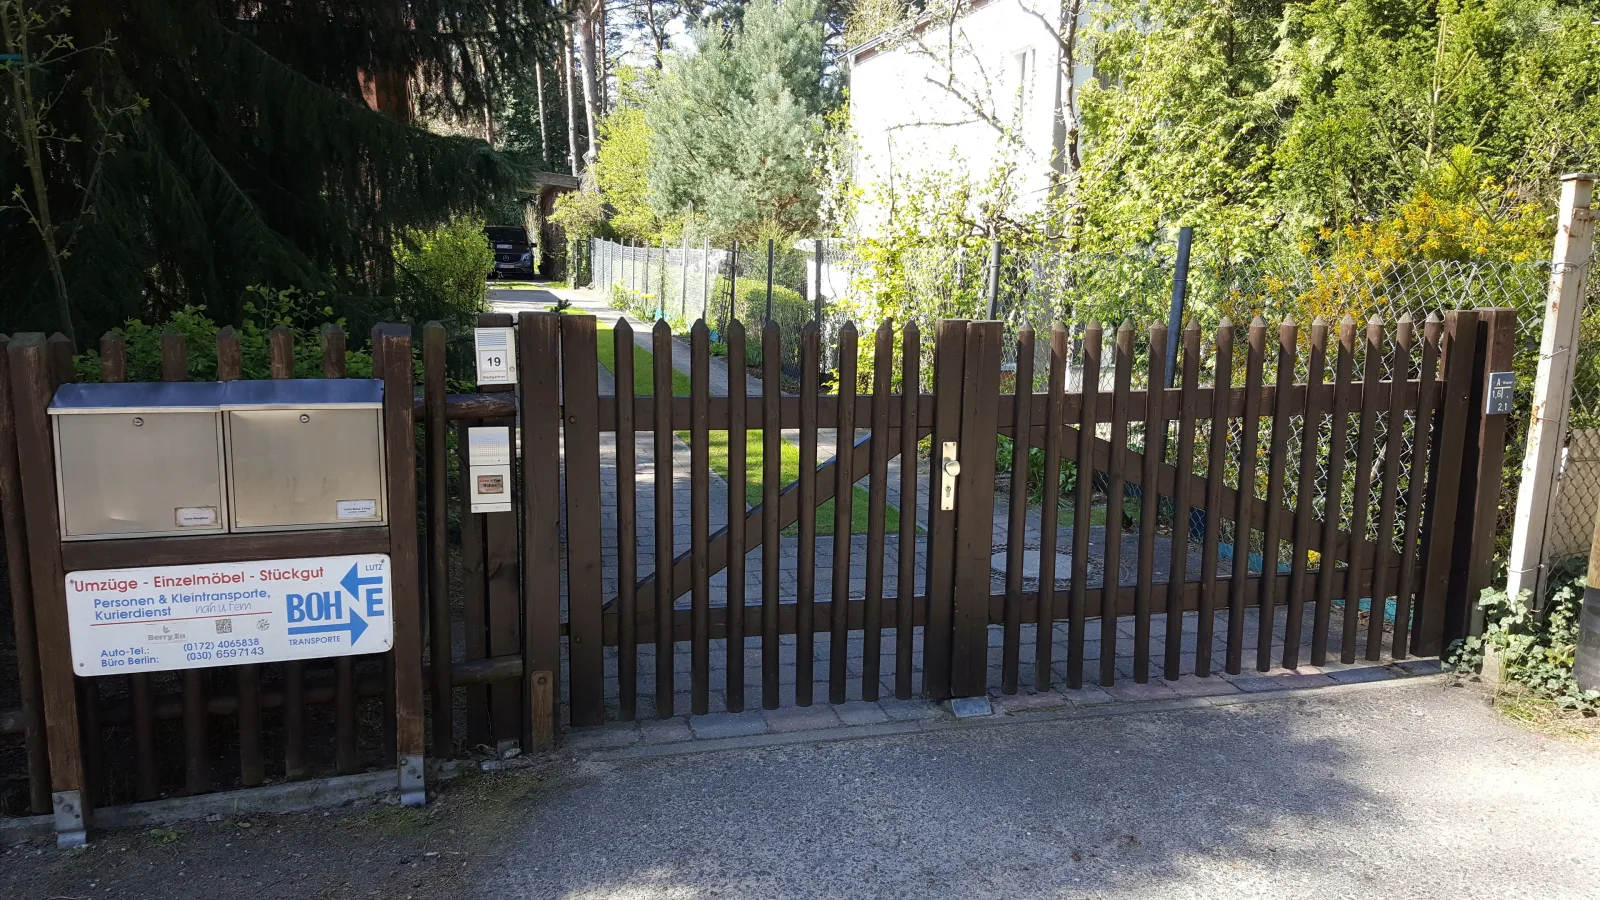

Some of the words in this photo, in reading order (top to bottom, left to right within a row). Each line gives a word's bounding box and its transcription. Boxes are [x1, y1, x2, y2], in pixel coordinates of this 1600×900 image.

[487, 357, 501, 367] 19
[365, 564, 383, 572] LUTZ
[74, 578, 138, 593] Umzüge
[153, 571, 245, 588] Einzelmöbel
[259, 566, 324, 582] Stückgut
[94, 596, 154, 608] Personen
[158, 594, 168, 604] &
[171, 588, 271, 604] Kleintransporte,
[95, 606, 171, 620] Kurierdienst
[101, 647, 150, 658] Auto-Tel.:
[183, 641, 215, 652] (0172)
[217, 638, 260, 649] 4065838
[288, 635, 341, 646] TRANSPORTE
[101, 658, 125, 667] Büro
[128, 656, 159, 666] Berlin:
[186, 651, 212, 662] (030)
